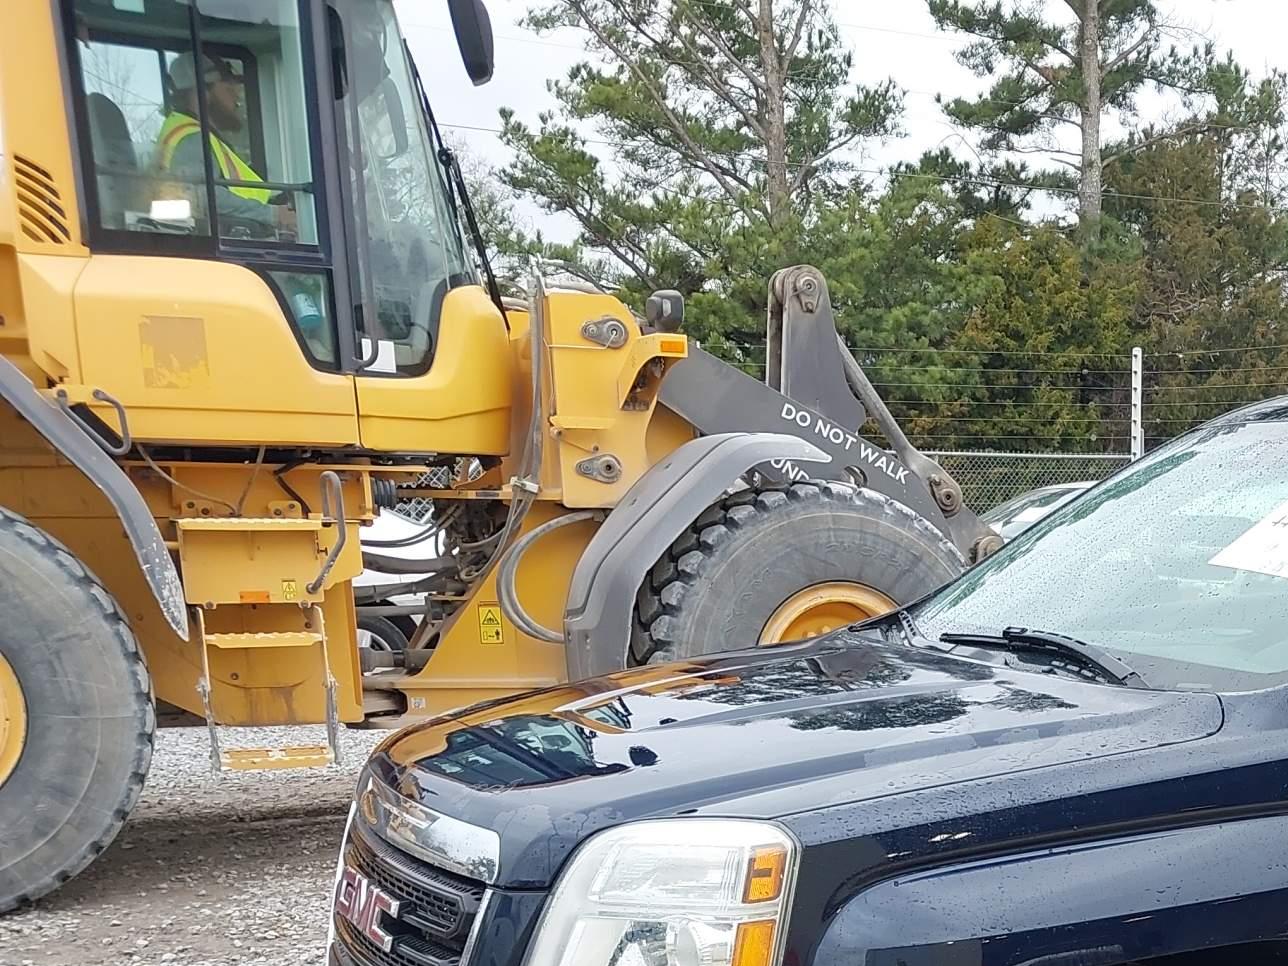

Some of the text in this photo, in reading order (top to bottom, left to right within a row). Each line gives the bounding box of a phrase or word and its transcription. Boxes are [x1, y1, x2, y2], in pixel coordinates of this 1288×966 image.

[781, 403, 909, 484] DO NOT WALK
[334, 865, 400, 952] GMC
